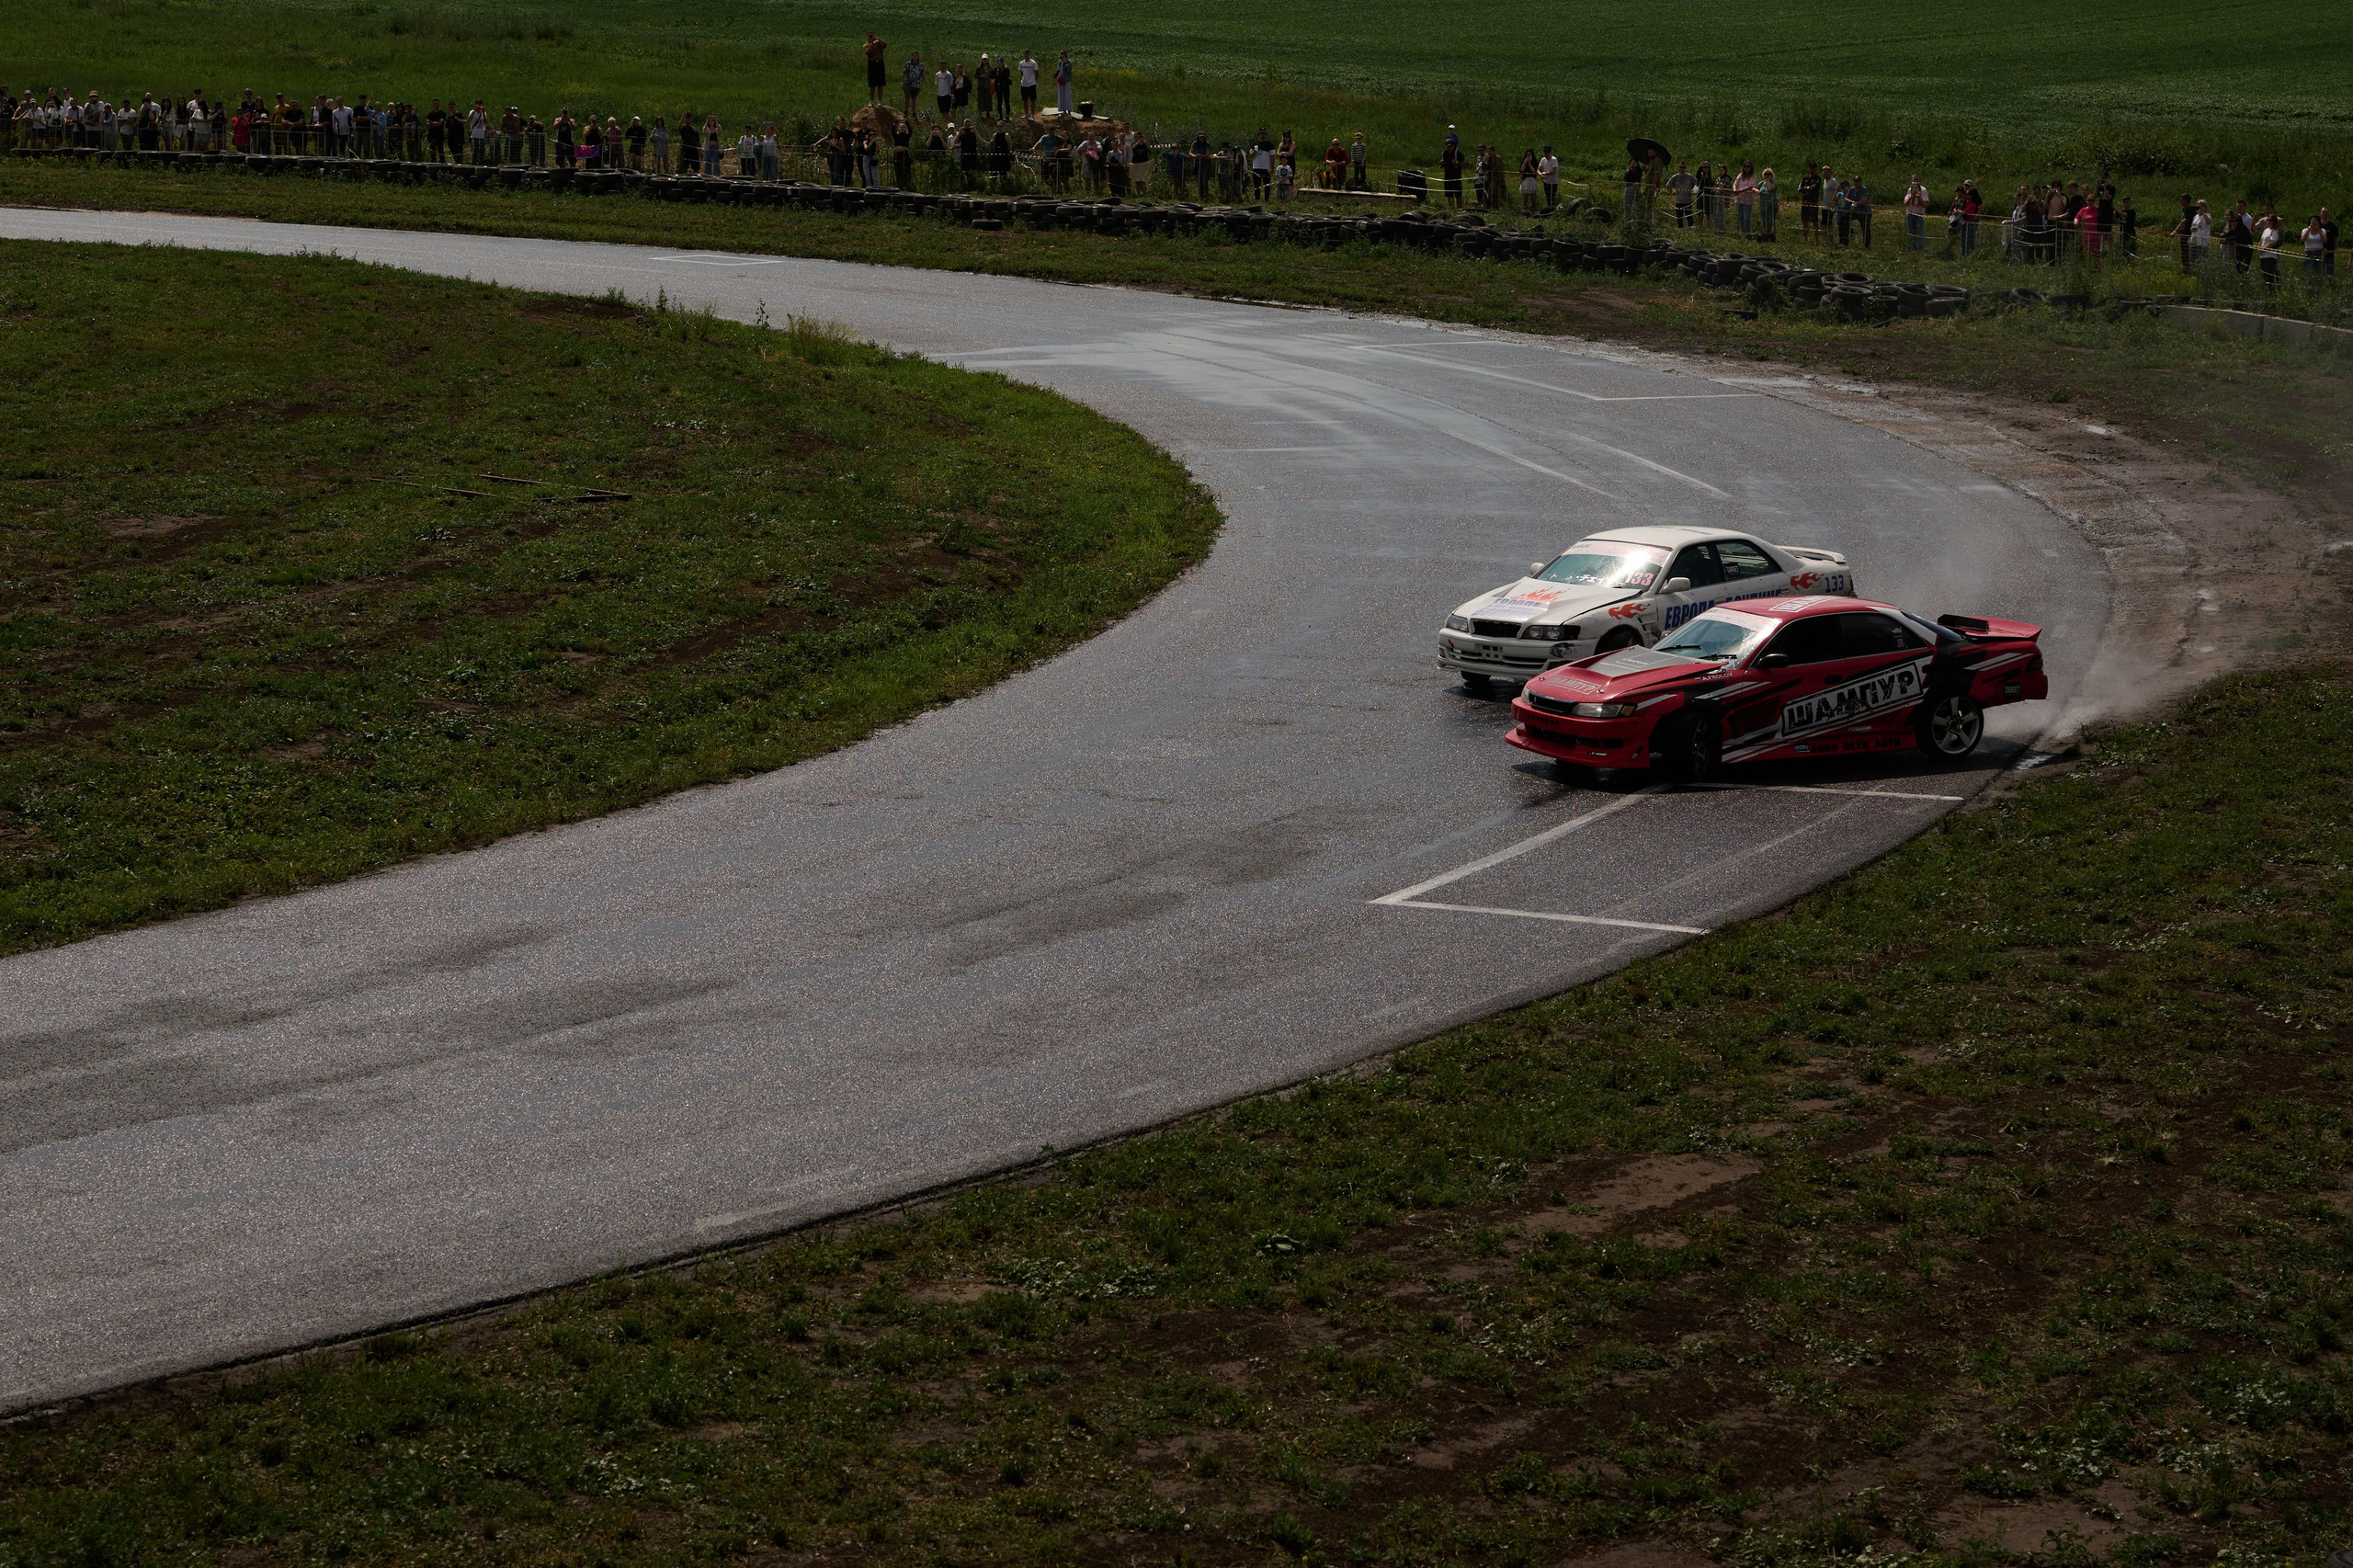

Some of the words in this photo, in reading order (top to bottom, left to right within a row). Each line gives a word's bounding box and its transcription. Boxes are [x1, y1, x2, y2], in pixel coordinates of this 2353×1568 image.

[1625, 572, 1654, 586] 133
[1824, 574, 1844, 593] 133
[1548, 676, 1597, 692] ШАМПУР
[1788, 671, 1915, 728] ШАМПУР
